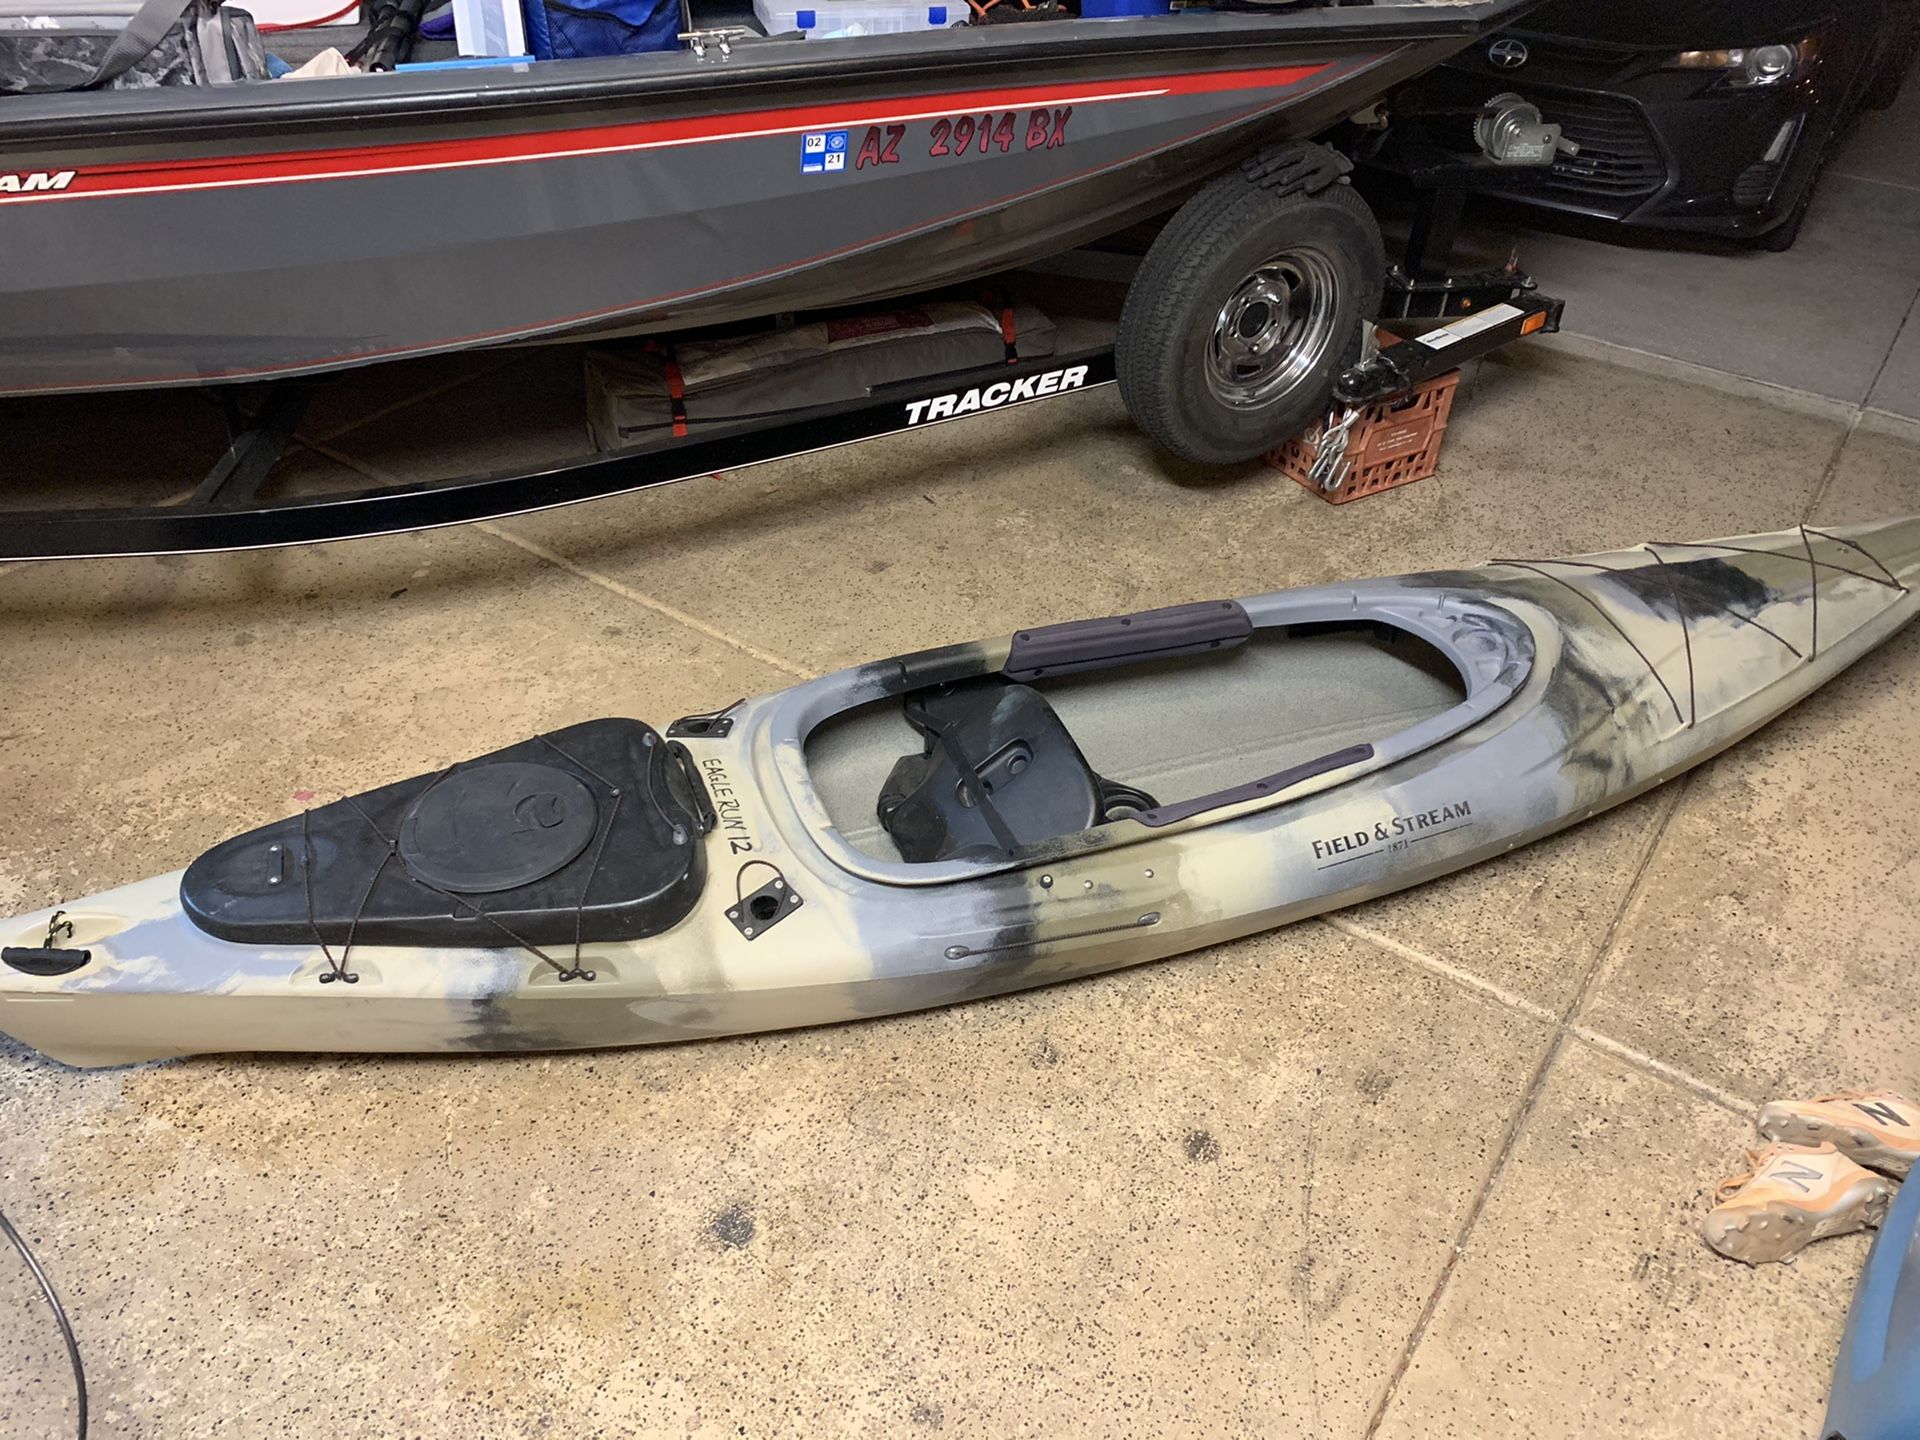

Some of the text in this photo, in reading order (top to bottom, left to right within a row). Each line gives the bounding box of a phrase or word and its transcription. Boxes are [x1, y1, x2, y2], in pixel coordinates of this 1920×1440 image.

[807, 137, 822, 148] 02
[855, 106, 1073, 170] AZ 2914 BX
[827, 153, 841, 164] 21
[905, 365, 1089, 425] TRACKER
[1311, 800, 1473, 859] FIELD & STREAM
[727, 836, 753, 855] 12
[1387, 839, 1409, 853] 1871
[1852, 1102, 1912, 1127] N
